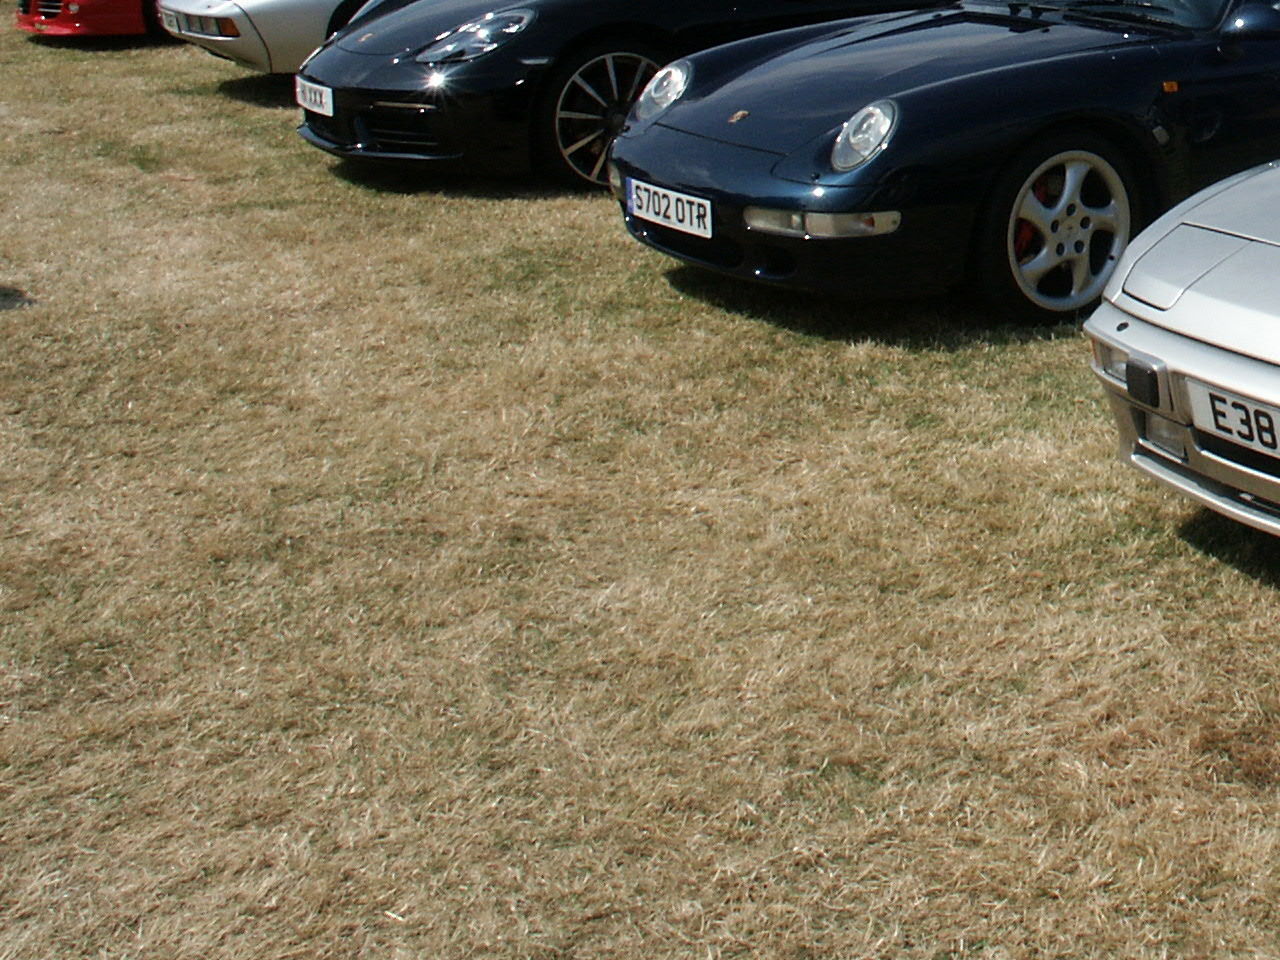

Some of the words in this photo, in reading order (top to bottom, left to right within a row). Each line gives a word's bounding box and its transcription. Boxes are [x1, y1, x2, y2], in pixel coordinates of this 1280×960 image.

[635, 184, 671, 220] S702
[675, 196, 708, 231] OTR
[1208, 391, 1278, 451] E38
